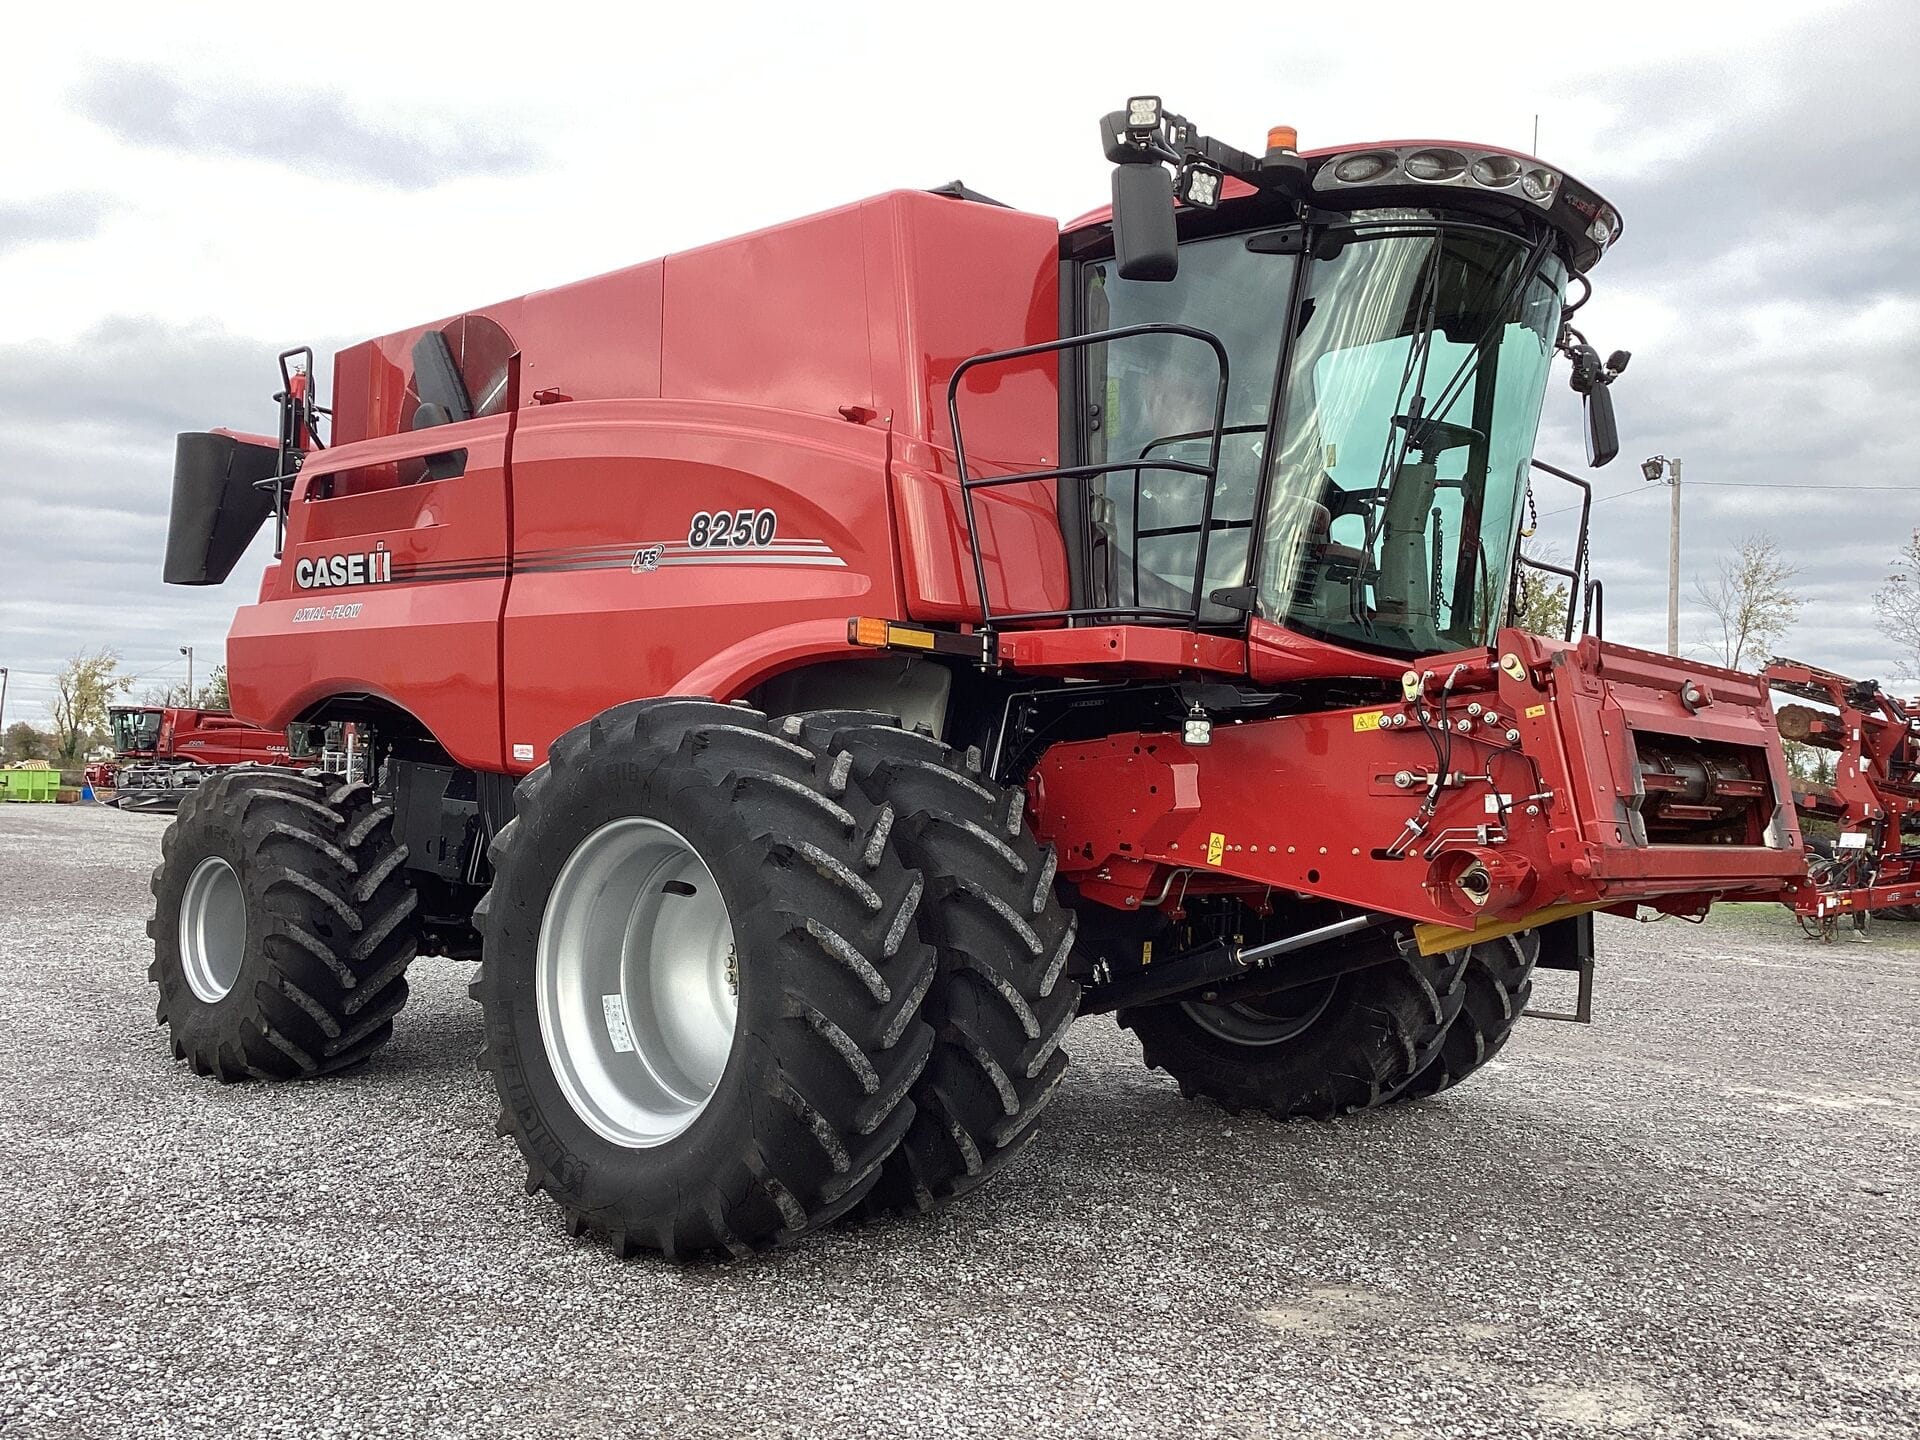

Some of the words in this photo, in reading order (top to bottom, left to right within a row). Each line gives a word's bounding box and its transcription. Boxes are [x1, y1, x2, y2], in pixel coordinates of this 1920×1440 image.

[688, 508, 777, 549] 8250
[632, 549, 658, 565] AFS
[295, 554, 365, 589] CASE
[292, 603, 363, 623] AXIAL-FLOW
